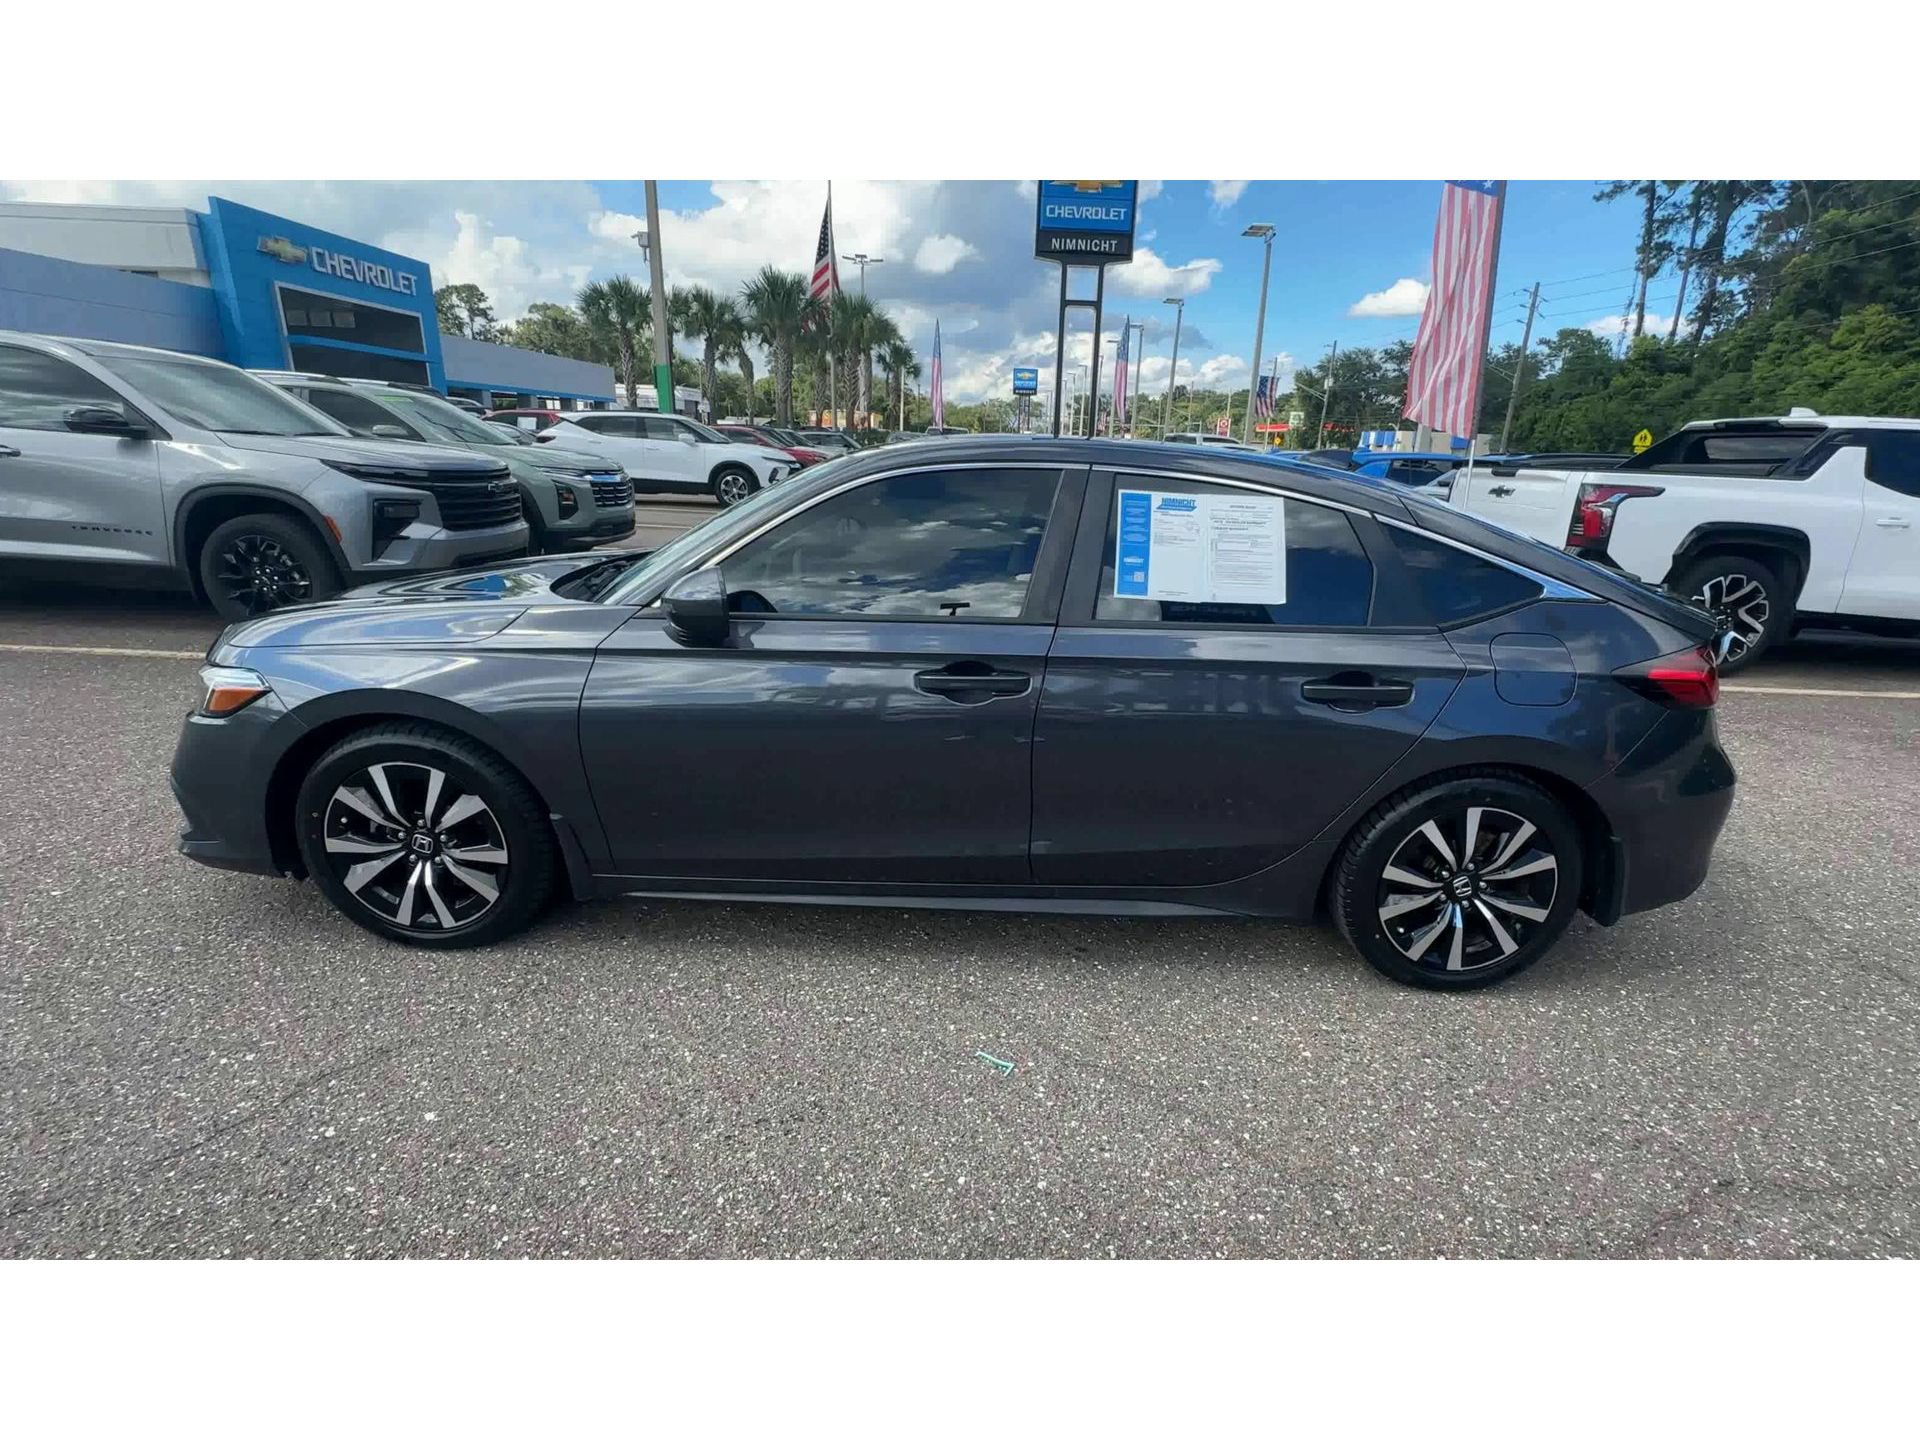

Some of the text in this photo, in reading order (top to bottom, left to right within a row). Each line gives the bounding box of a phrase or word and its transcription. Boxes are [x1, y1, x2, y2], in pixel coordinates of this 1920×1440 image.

[1046, 205, 1127, 220] CHEVROLET
[1051, 238, 1118, 252] NIMNICHT
[311, 246, 418, 296] CHEVROLET
